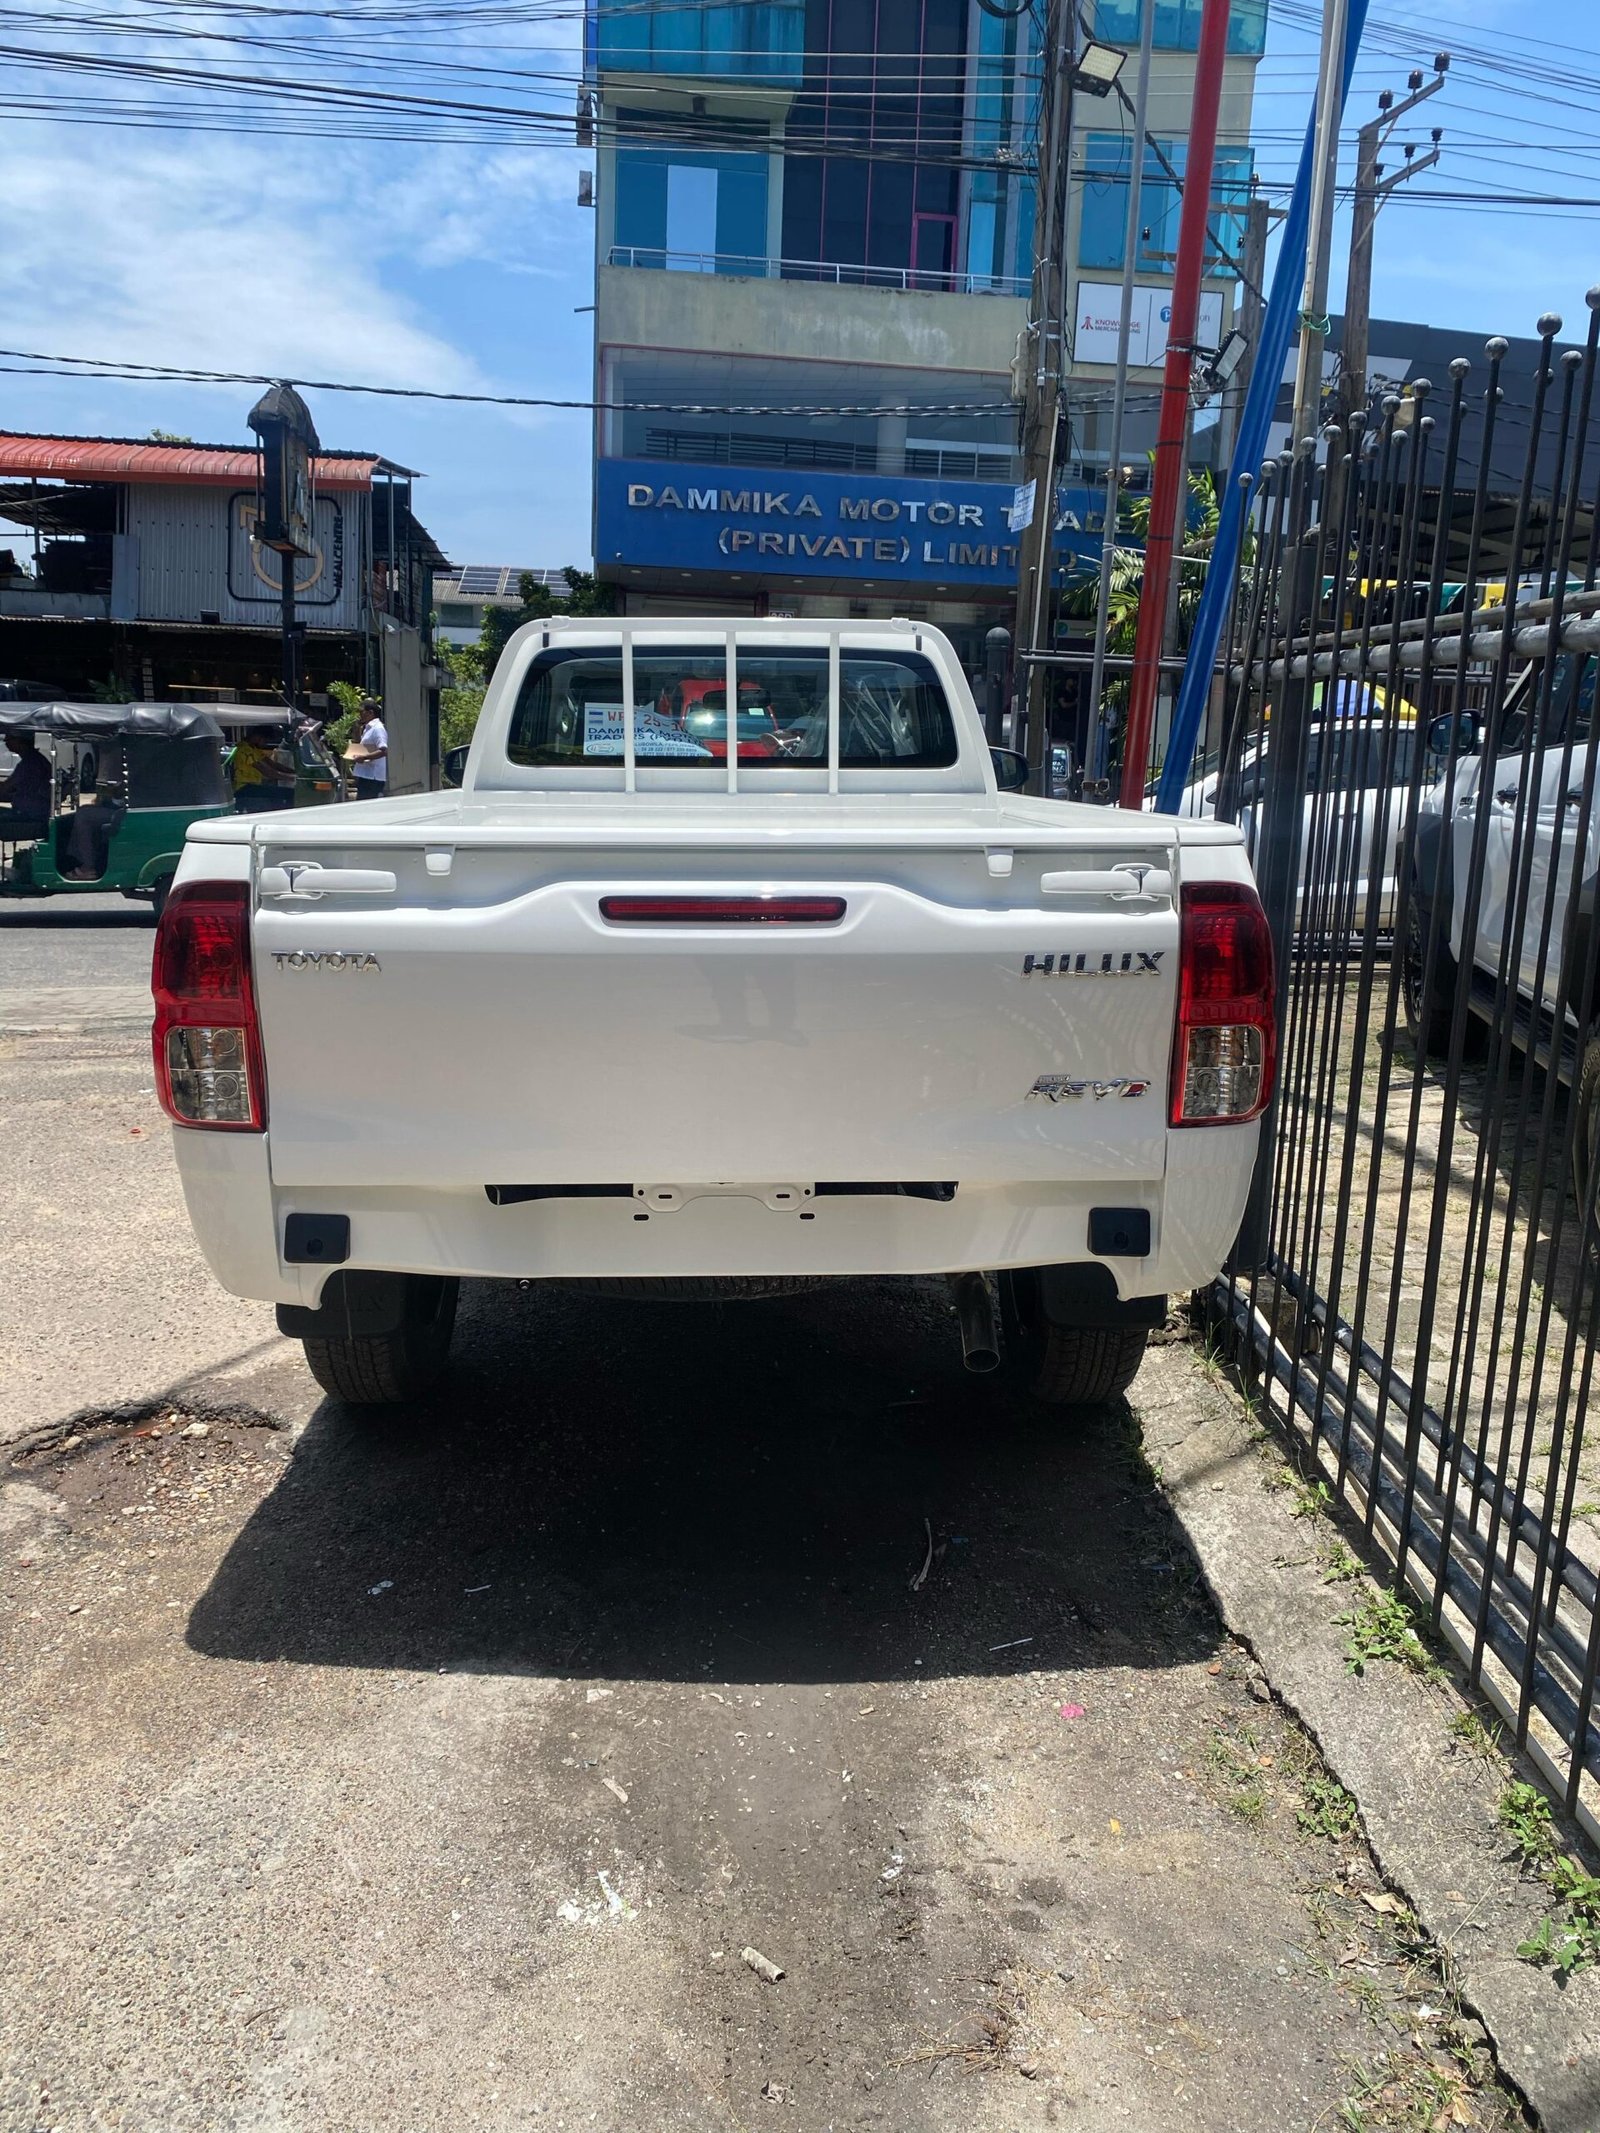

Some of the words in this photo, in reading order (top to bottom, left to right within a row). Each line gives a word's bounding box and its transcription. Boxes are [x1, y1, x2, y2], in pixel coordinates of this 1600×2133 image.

[628, 484, 822, 517] DAMMIKA
[839, 498, 984, 527] MOTOR
[718, 527, 910, 563] (PRIVATE)
[924, 541, 1077, 569] LIMITD
[271, 950, 382, 972] TOYOTA
[1021, 951, 1165, 978] HILUX
